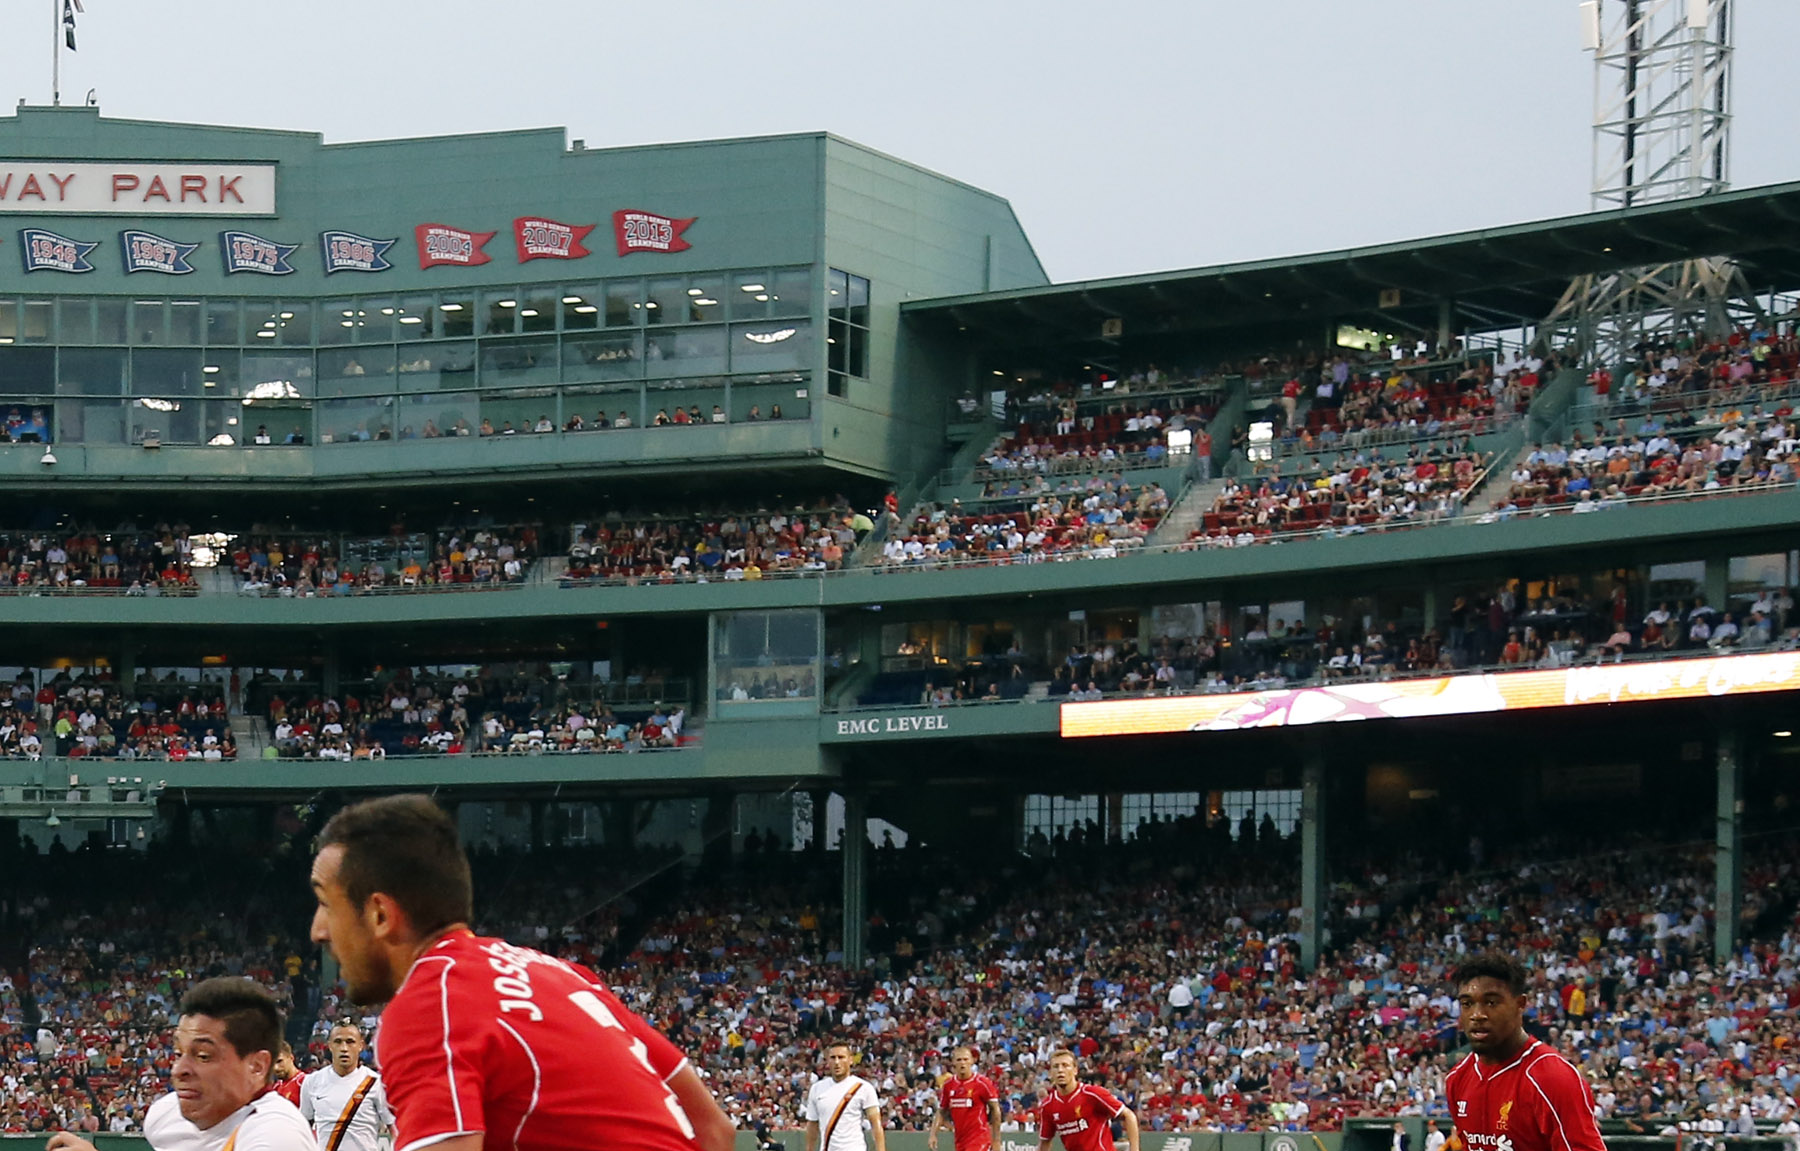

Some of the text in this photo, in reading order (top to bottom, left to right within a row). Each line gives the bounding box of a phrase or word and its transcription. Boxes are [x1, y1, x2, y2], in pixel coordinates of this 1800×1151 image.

[111, 173, 245, 204] PARK
[524, 221, 547, 229] WORLD
[624, 220, 673, 243] 2013
[428, 228, 450, 236] WORLD
[426, 235, 473, 256] 2004
[523, 228, 573, 250] 2007
[628, 240, 669, 250] CHAMPIONS
[31, 239, 77, 264] 1946
[132, 241, 178, 265] 1967
[232, 241, 278, 266] 1975
[431, 252, 469, 262] CHAMPIONS
[528, 247, 569, 256] CHAMPIONS
[35, 257, 73, 270] CHAMPIONS
[135, 259, 174, 271] CHAMPIONS
[236, 259, 274, 272] CHAMPIONS
[333, 258, 371, 269] CHAMPIONS
[837, 715, 948, 734] EMC LEVEL
